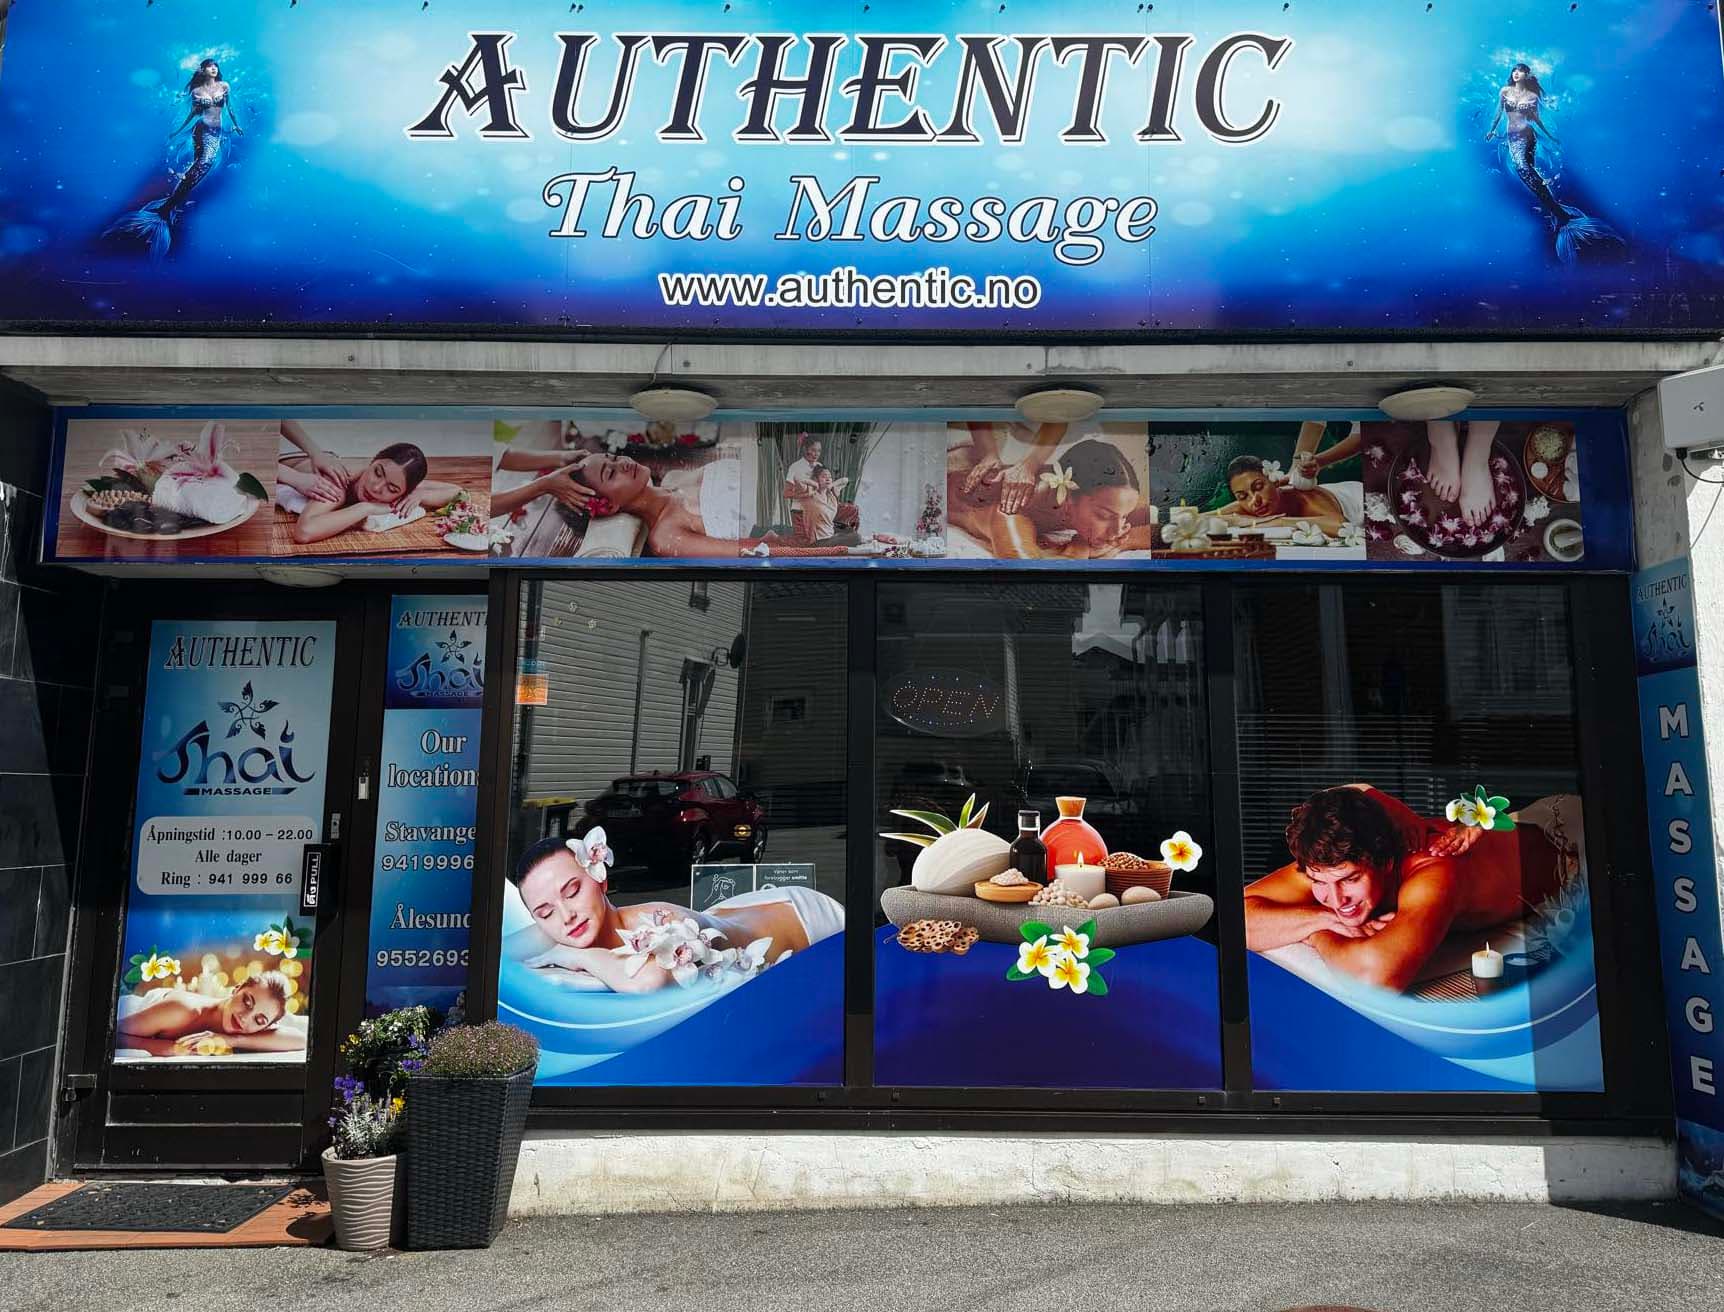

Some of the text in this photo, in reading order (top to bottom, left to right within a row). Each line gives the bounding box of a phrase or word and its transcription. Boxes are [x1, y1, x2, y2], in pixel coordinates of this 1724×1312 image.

[406, 31, 1292, 144] AUTHENTIC
[542, 166, 1159, 265] Thai Massage
[658, 266, 1042, 309] www.authentic.no
[1637, 575, 1688, 601] AUTHENTIC
[164, 635, 318, 669] AUTHENTIC
[893, 686, 1000, 719] OPEN
[420, 729, 467, 754] Our
[388, 763, 479, 788] location
[200, 787, 272, 796] MASSAGE
[146, 825, 215, 844] Åpningstid
[277, 829, 313, 840] 22.00
[195, 850, 262, 865] Alle dager
[310, 855, 319, 885] PULL
[382, 855, 475, 871] 9419996
[161, 871, 191, 888] Ring
[208, 873, 232, 885] 941
[242, 873, 268, 885] 999
[276, 873, 293, 885] 66
[1658, 702, 1717, 1097] MASSAGE
